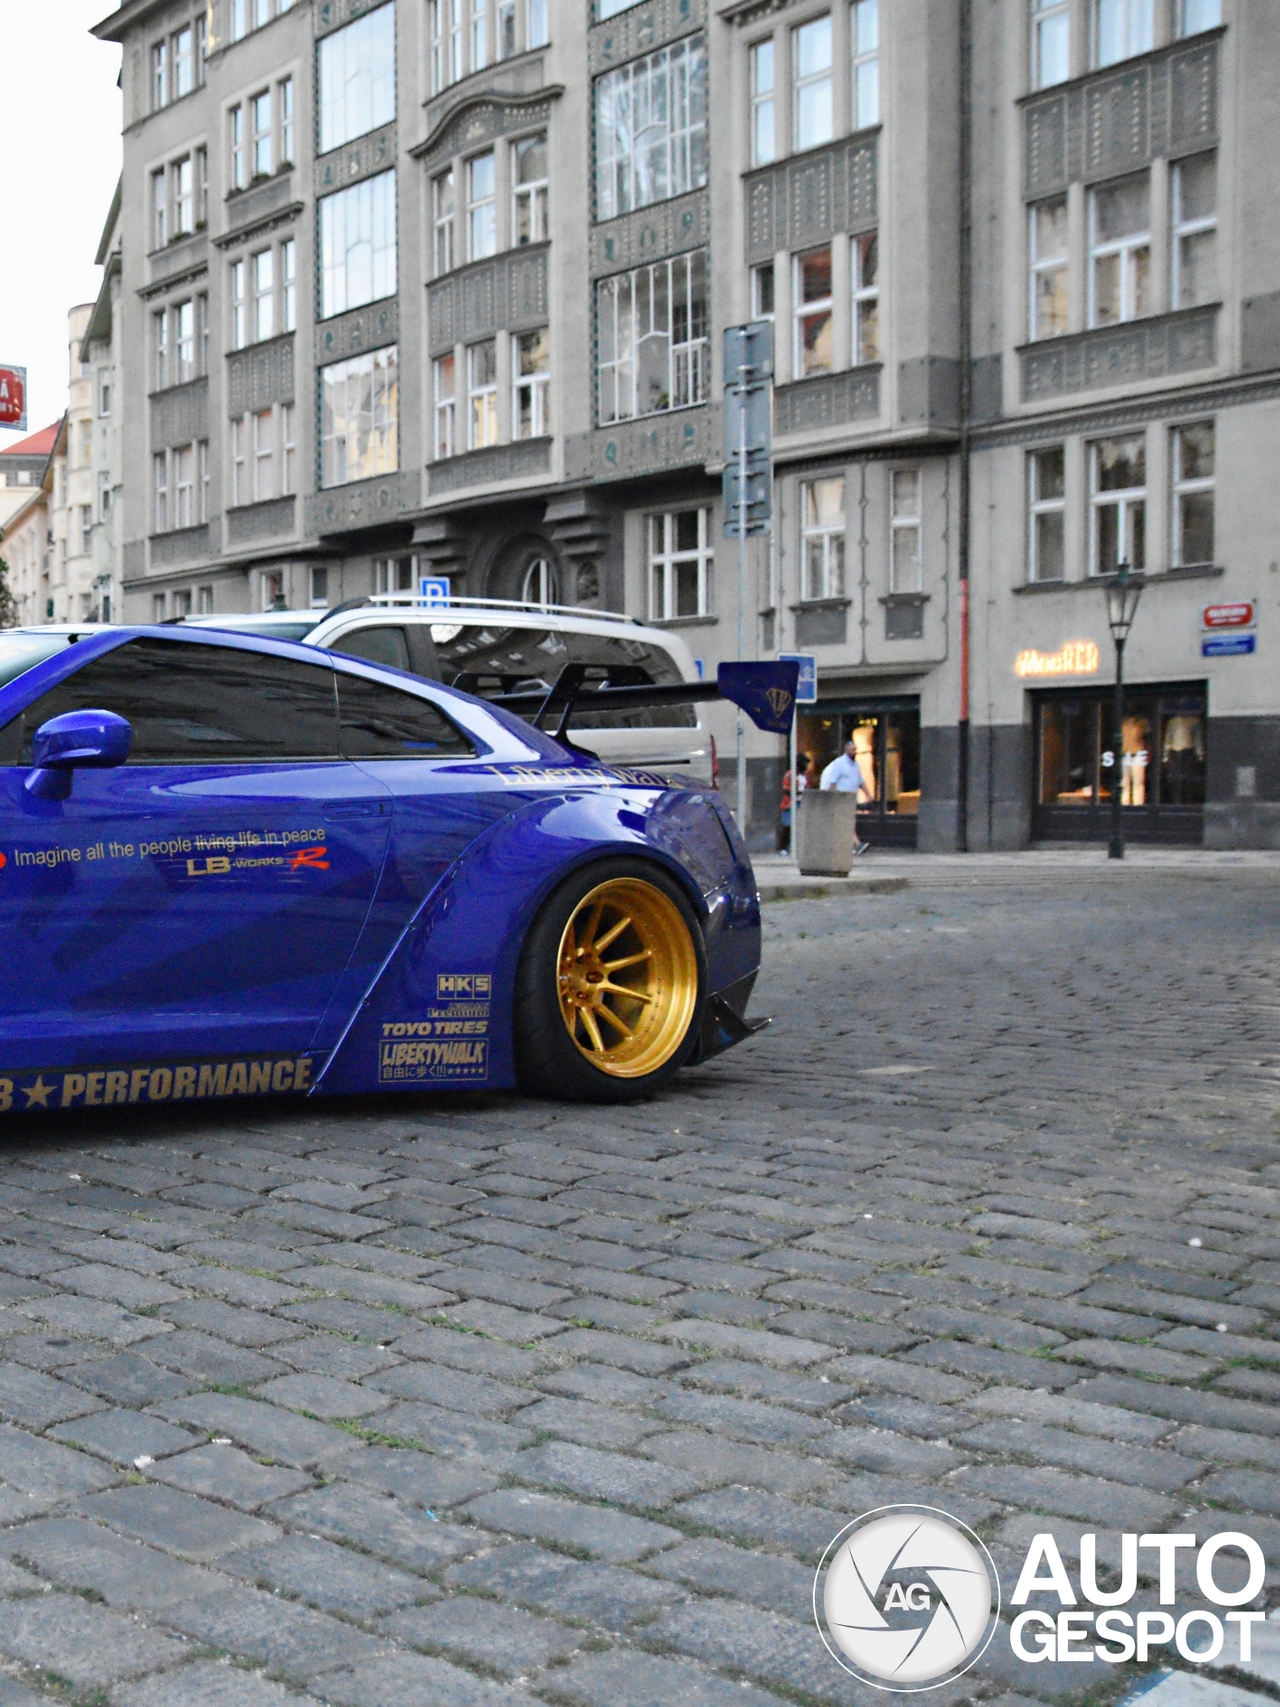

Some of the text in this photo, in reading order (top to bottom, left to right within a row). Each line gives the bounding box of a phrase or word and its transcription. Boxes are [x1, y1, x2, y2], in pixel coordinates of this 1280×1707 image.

[1102, 750, 1150, 768] SLE
[484, 765, 611, 790] Liberty
[14, 828, 326, 868] Imagine all the people living life in peace
[439, 977, 489, 991] HKS
[382, 1021, 488, 1036] TOYO TIRES
[61, 1058, 314, 1107] PERFORMANCE
